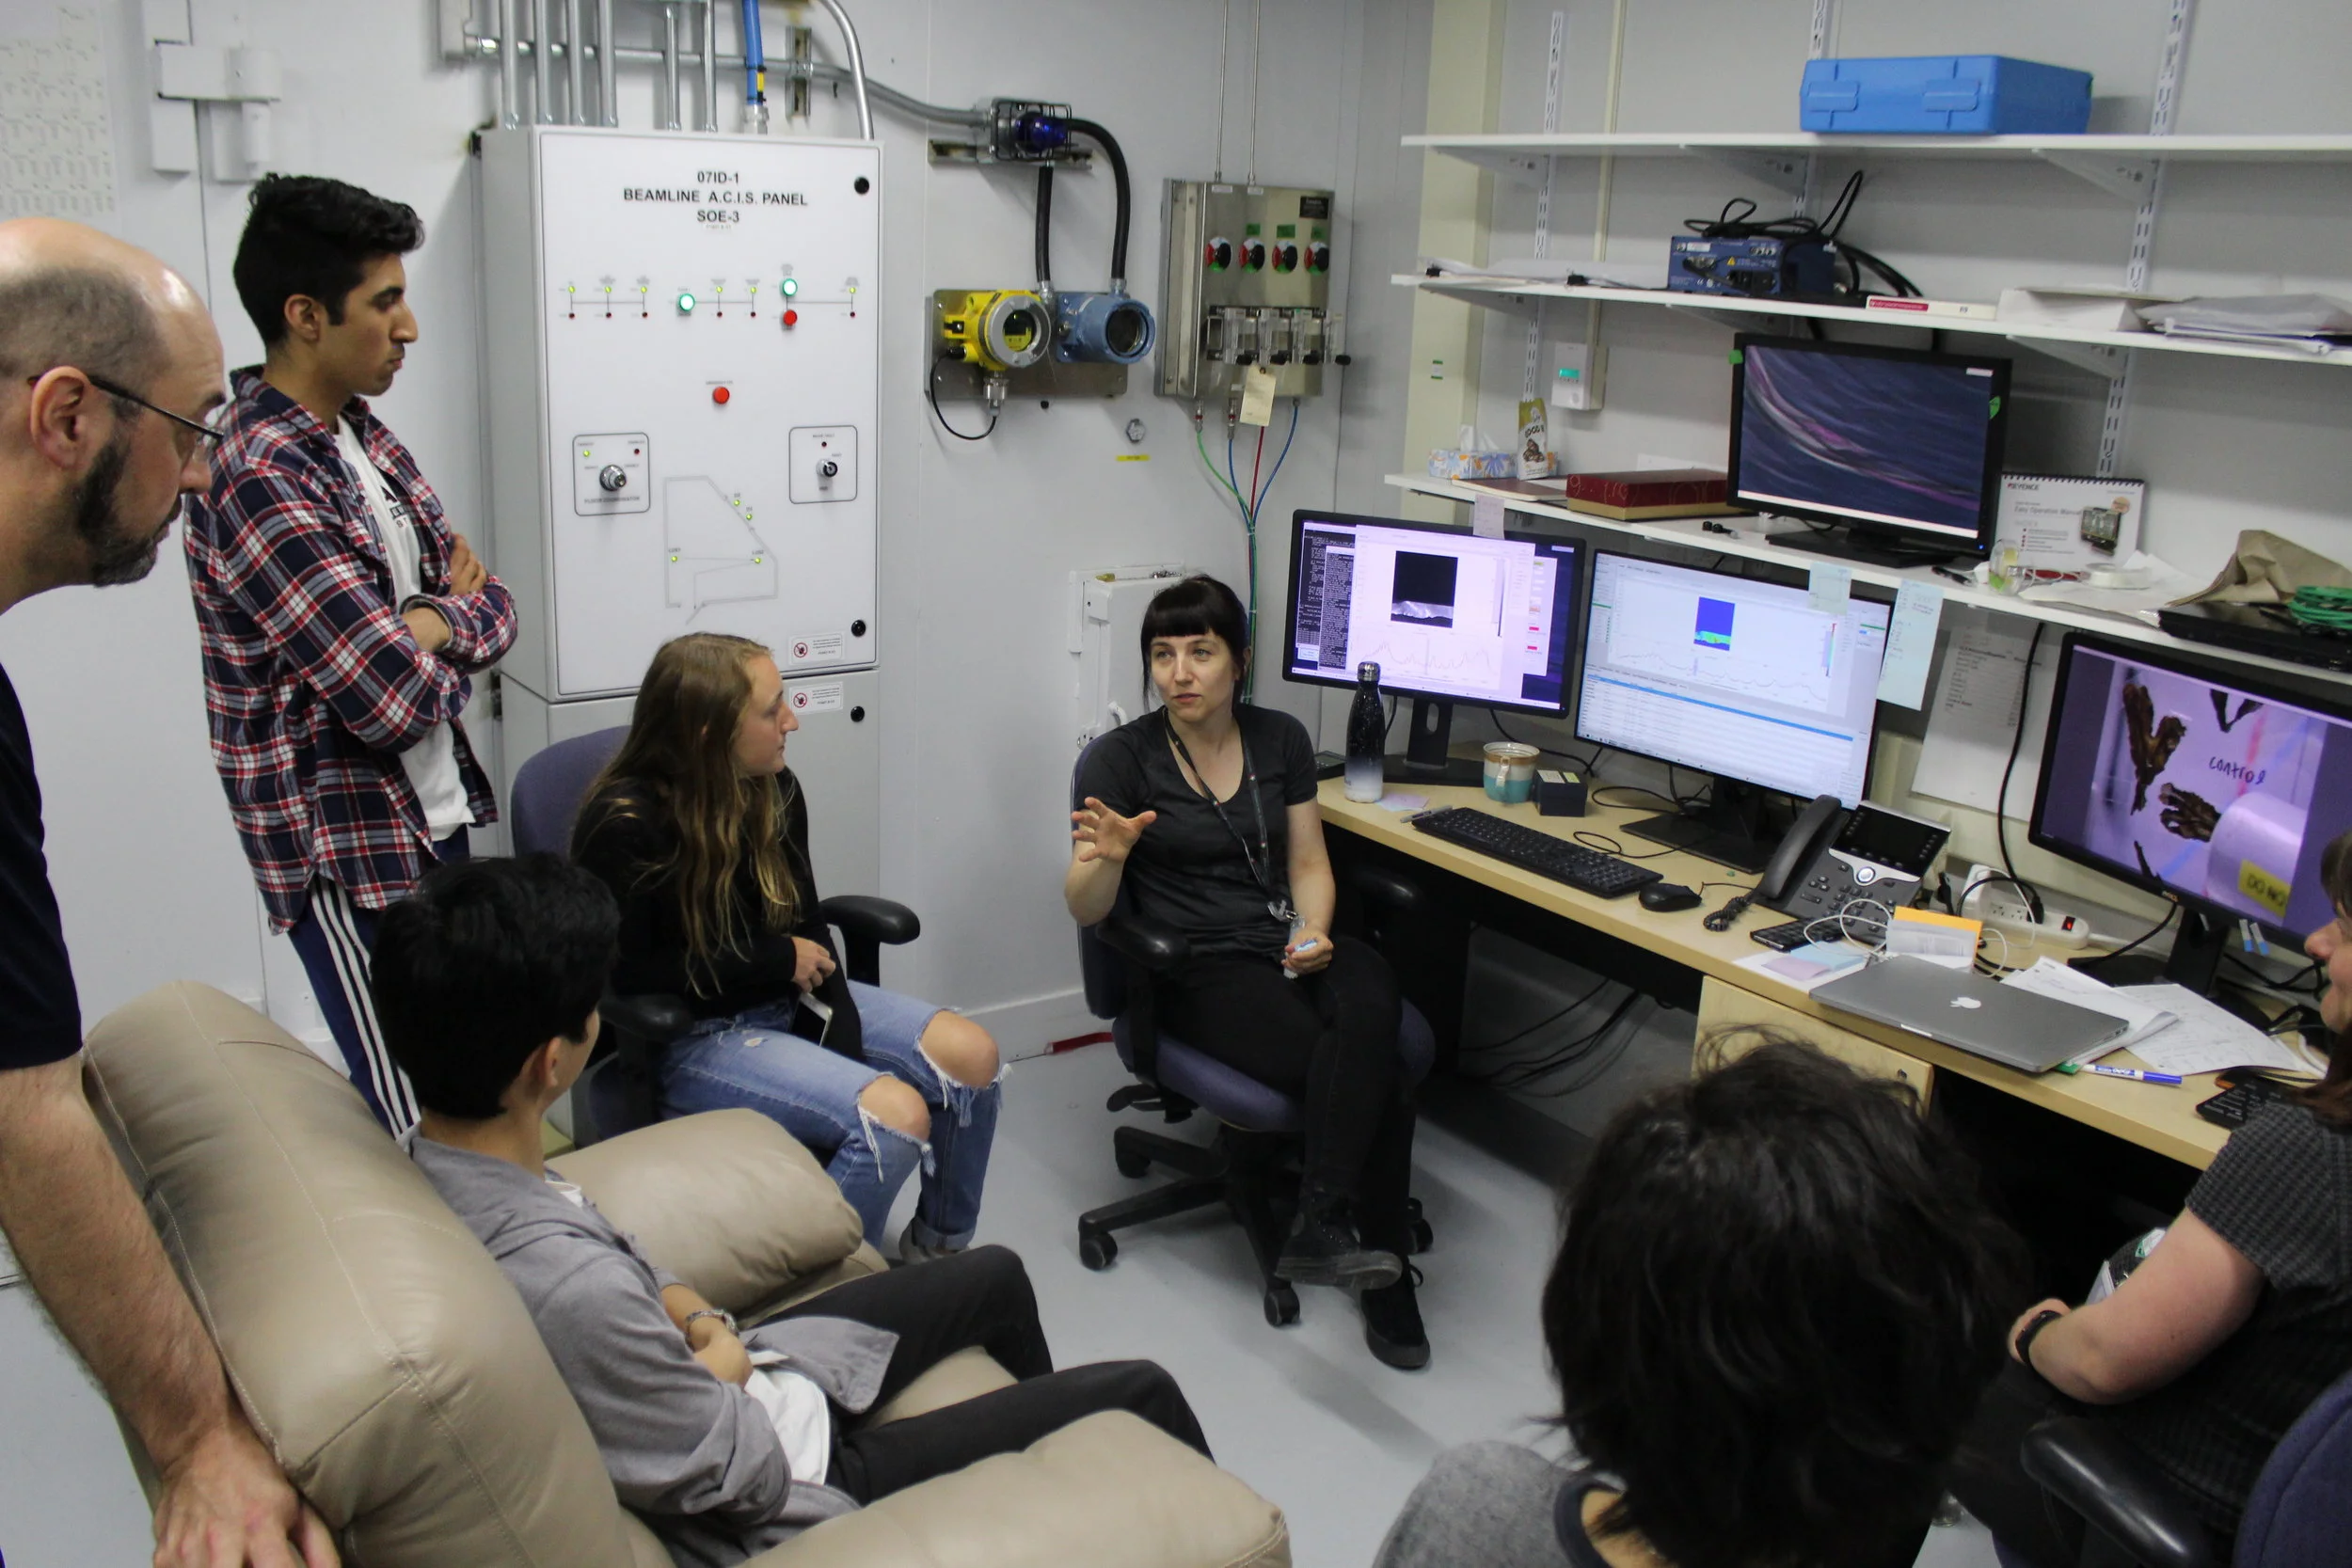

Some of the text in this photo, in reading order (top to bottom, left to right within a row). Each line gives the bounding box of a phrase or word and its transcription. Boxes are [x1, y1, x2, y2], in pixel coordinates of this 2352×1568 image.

[696, 171, 740, 184] 07ID-1
[623, 188, 808, 206] BEAMLINE A.C.I.S. PANEL
[696, 209, 740, 223] SOE-3
